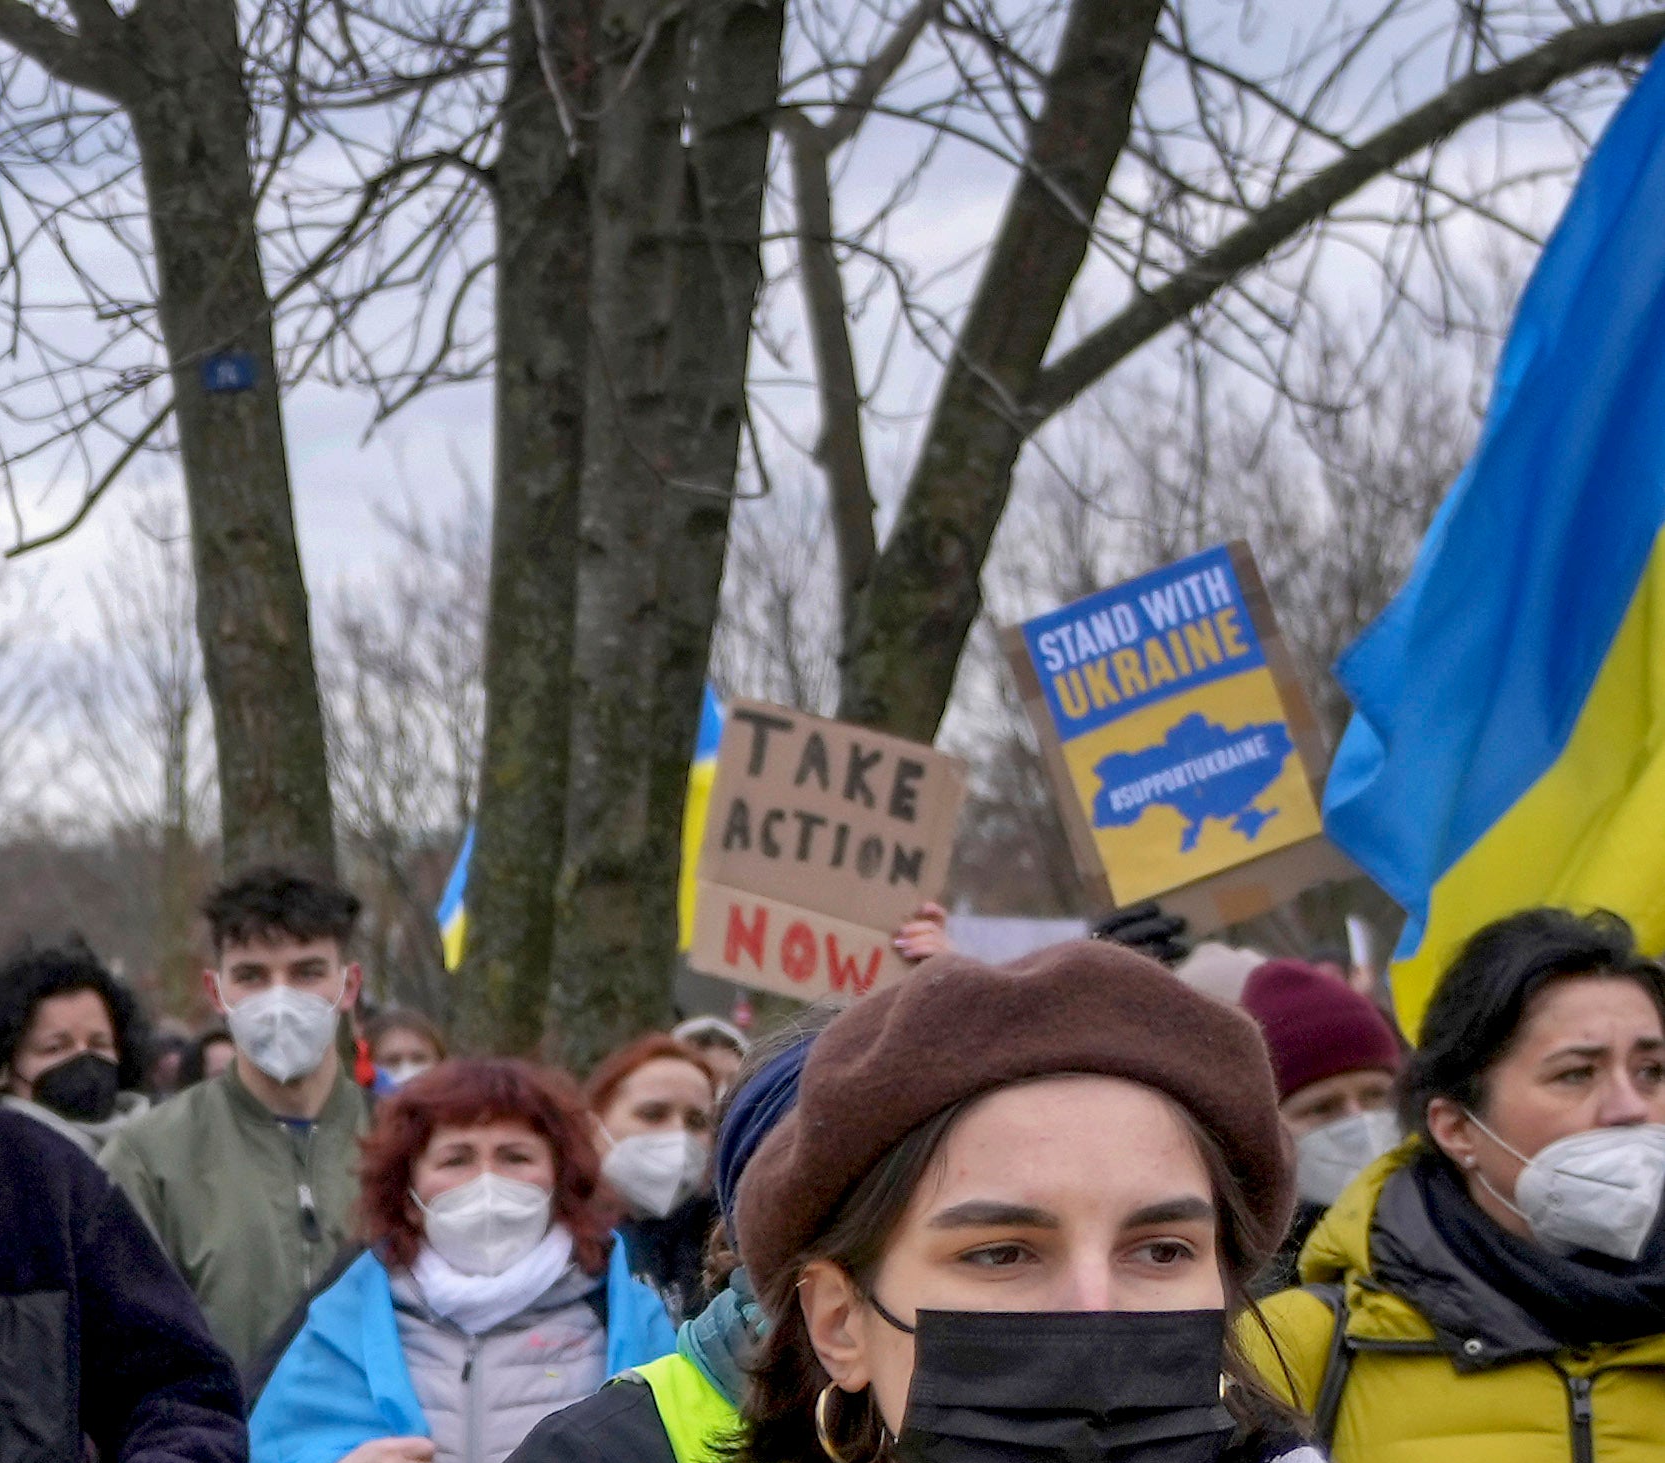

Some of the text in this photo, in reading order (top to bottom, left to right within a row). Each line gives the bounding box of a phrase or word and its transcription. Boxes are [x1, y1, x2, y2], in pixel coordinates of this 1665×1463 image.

[1038, 566, 1232, 672] STAND WITH
[1053, 606, 1249, 720] UKRAINE
[732, 707, 926, 823] TAKE
[1109, 733, 1271, 812] #SUPPORTUKRAINE
[721, 796, 926, 887] ACTION
[722, 902, 885, 997] NOW
